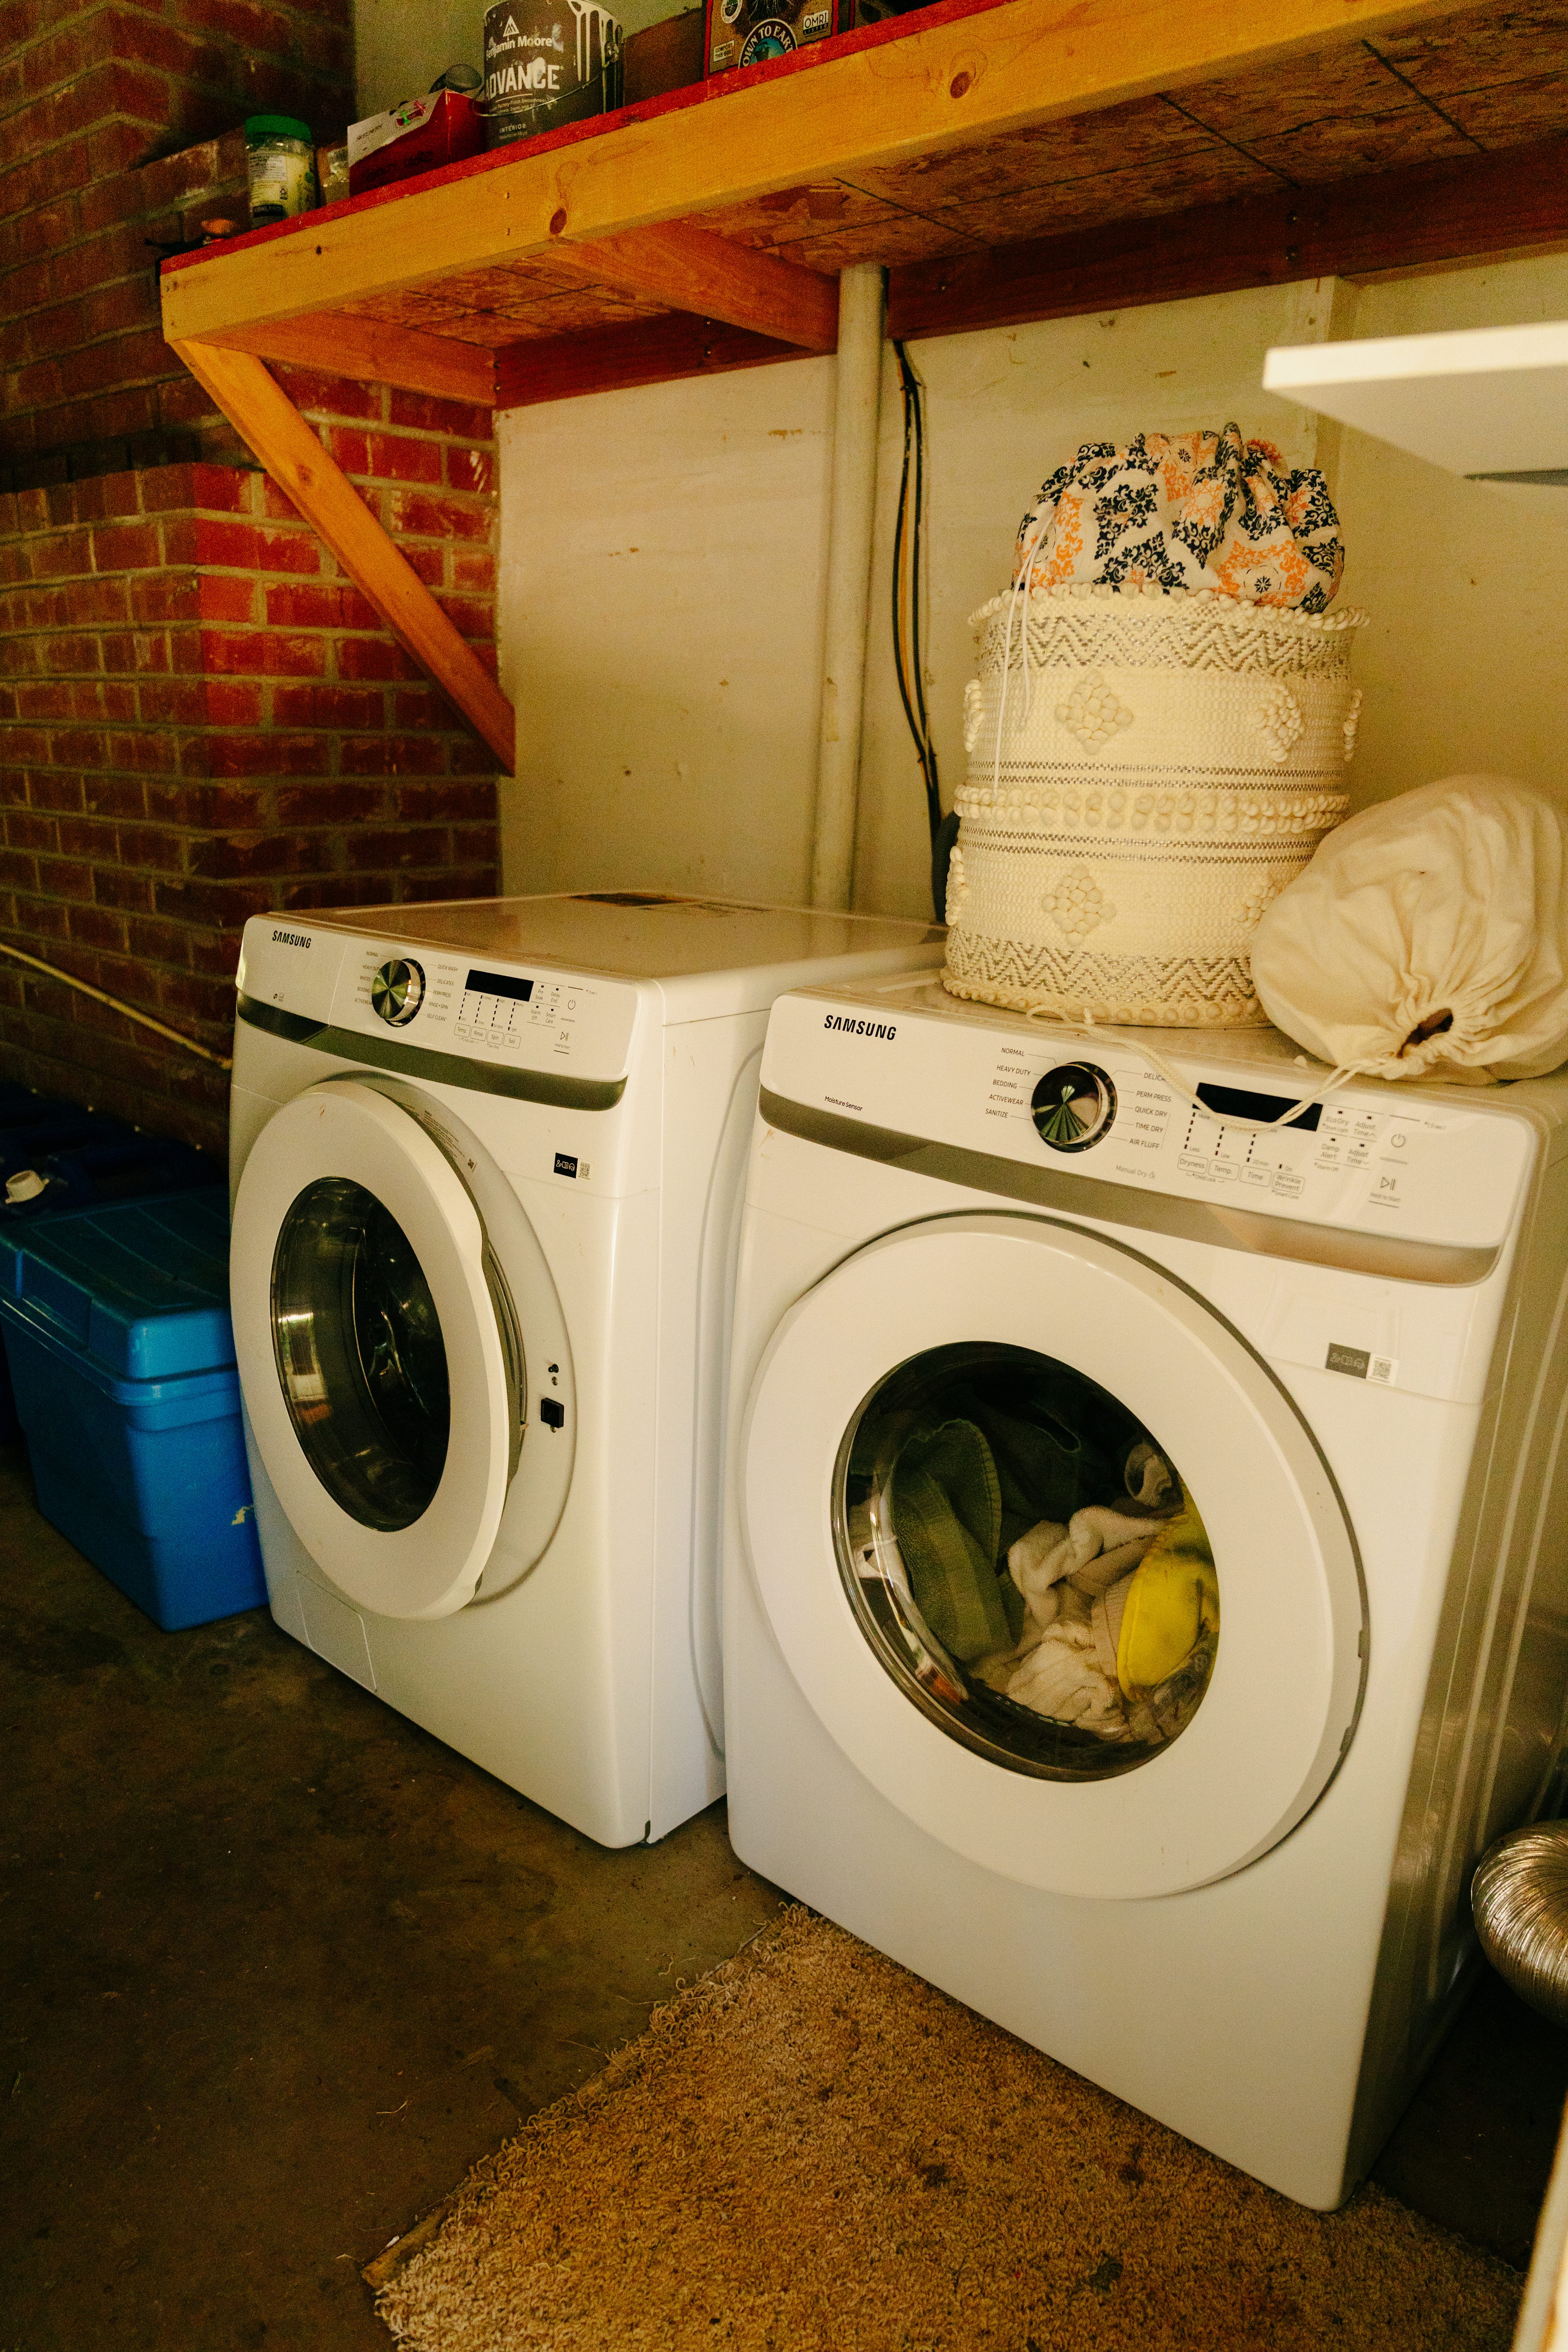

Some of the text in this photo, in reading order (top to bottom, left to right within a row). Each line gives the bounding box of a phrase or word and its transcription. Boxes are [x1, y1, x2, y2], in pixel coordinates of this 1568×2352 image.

[804, 13, 827, 28] OMRI
[517, 36, 552, 48] Moore
[742, 25, 794, 67] OWN TO EART
[272, 930, 312, 948] SAMSUNG
[824, 1015, 896, 1040] SAMSUNG
[1001, 1047, 1025, 1057] NORMAL
[996, 1065, 1015, 1073] HEAVY
[1143, 1072, 1167, 1082] DELICA
[993, 1079, 1017, 1089] BEDDING
[989, 1094, 1024, 1105] ACTIVEWEAR
[1136, 1091, 1172, 1102] PERM PRESS
[824, 1096, 863, 1111] Moisture Sensor
[985, 1109, 1009, 1118] SANITIZE
[1135, 1106, 1153, 1115] QUICK
[1355, 1122, 1376, 1130] Adjust
[1354, 1129, 1368, 1137] Time
[1140, 1140, 1160, 1149] FLUFF
[1321, 1143, 1339, 1152] Damp
[1320, 1152, 1336, 1160] Alert
[1348, 1149, 1369, 1158] Adjust
[1180, 1158, 1205, 1169] Dryness
[1347, 1156, 1361, 1164] Time
[1116, 1165, 1147, 1178] Manual Dry
[1214, 1165, 1232, 1174] Temp.
[1248, 1172, 1264, 1180] Time
[1277, 1175, 1301, 1184] Wrinkle
[1274, 1181, 1300, 1192] Prevent
